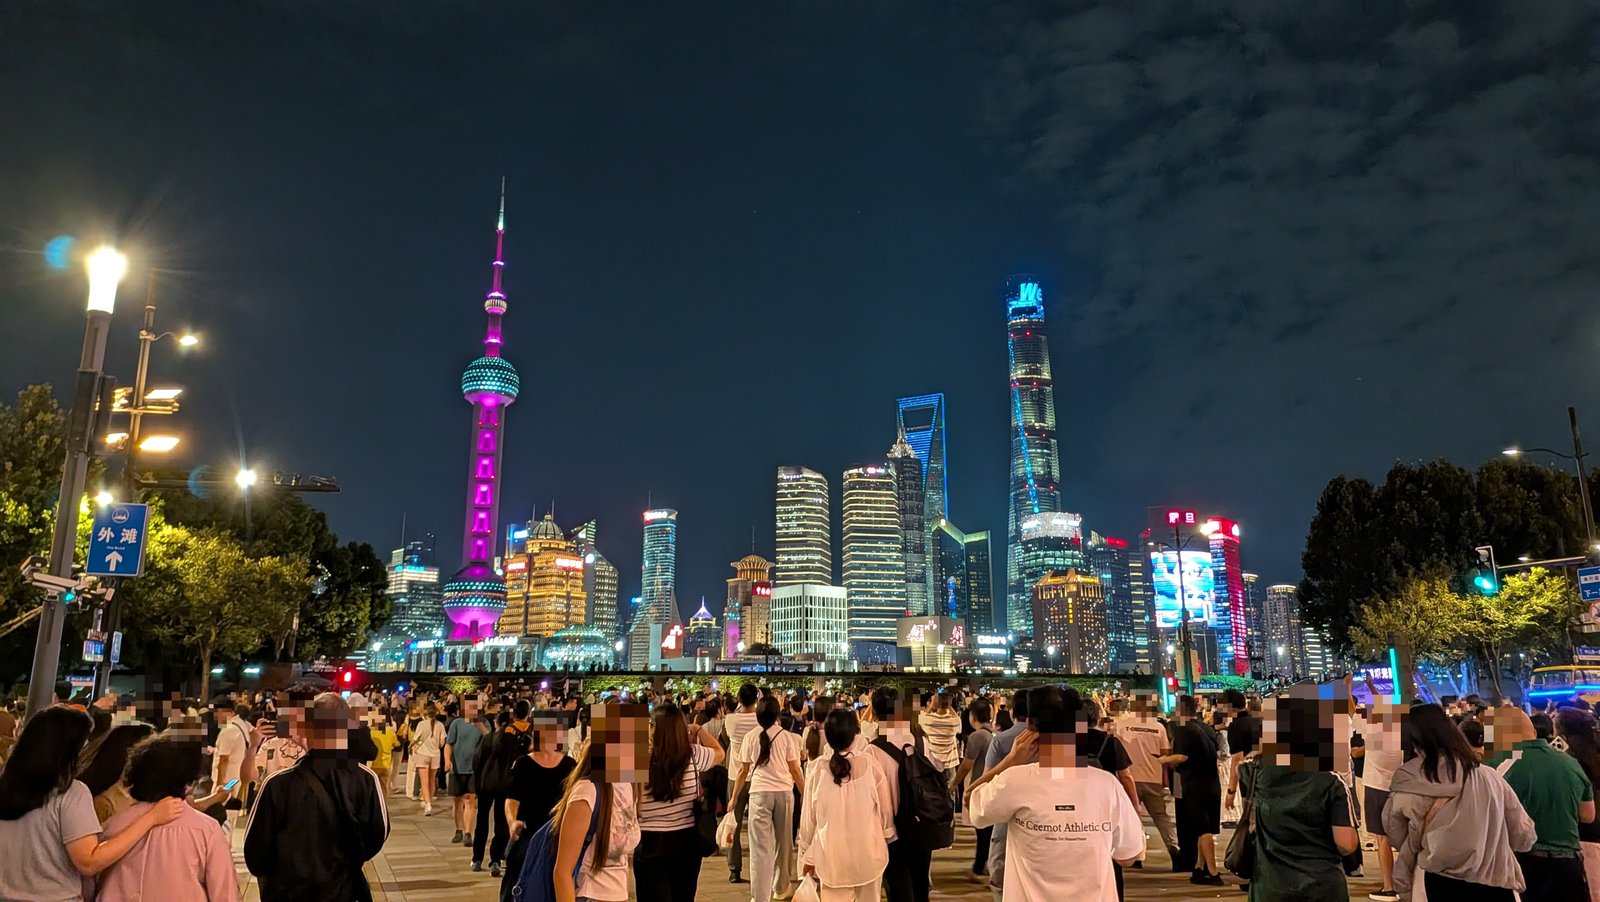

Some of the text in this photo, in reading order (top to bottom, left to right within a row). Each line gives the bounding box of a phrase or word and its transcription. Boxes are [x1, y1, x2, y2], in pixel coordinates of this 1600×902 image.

[97, 526, 138, 544] 外滩
[1026, 820, 1062, 832] Ceemot
[1064, 821, 1100, 833] Athletic
